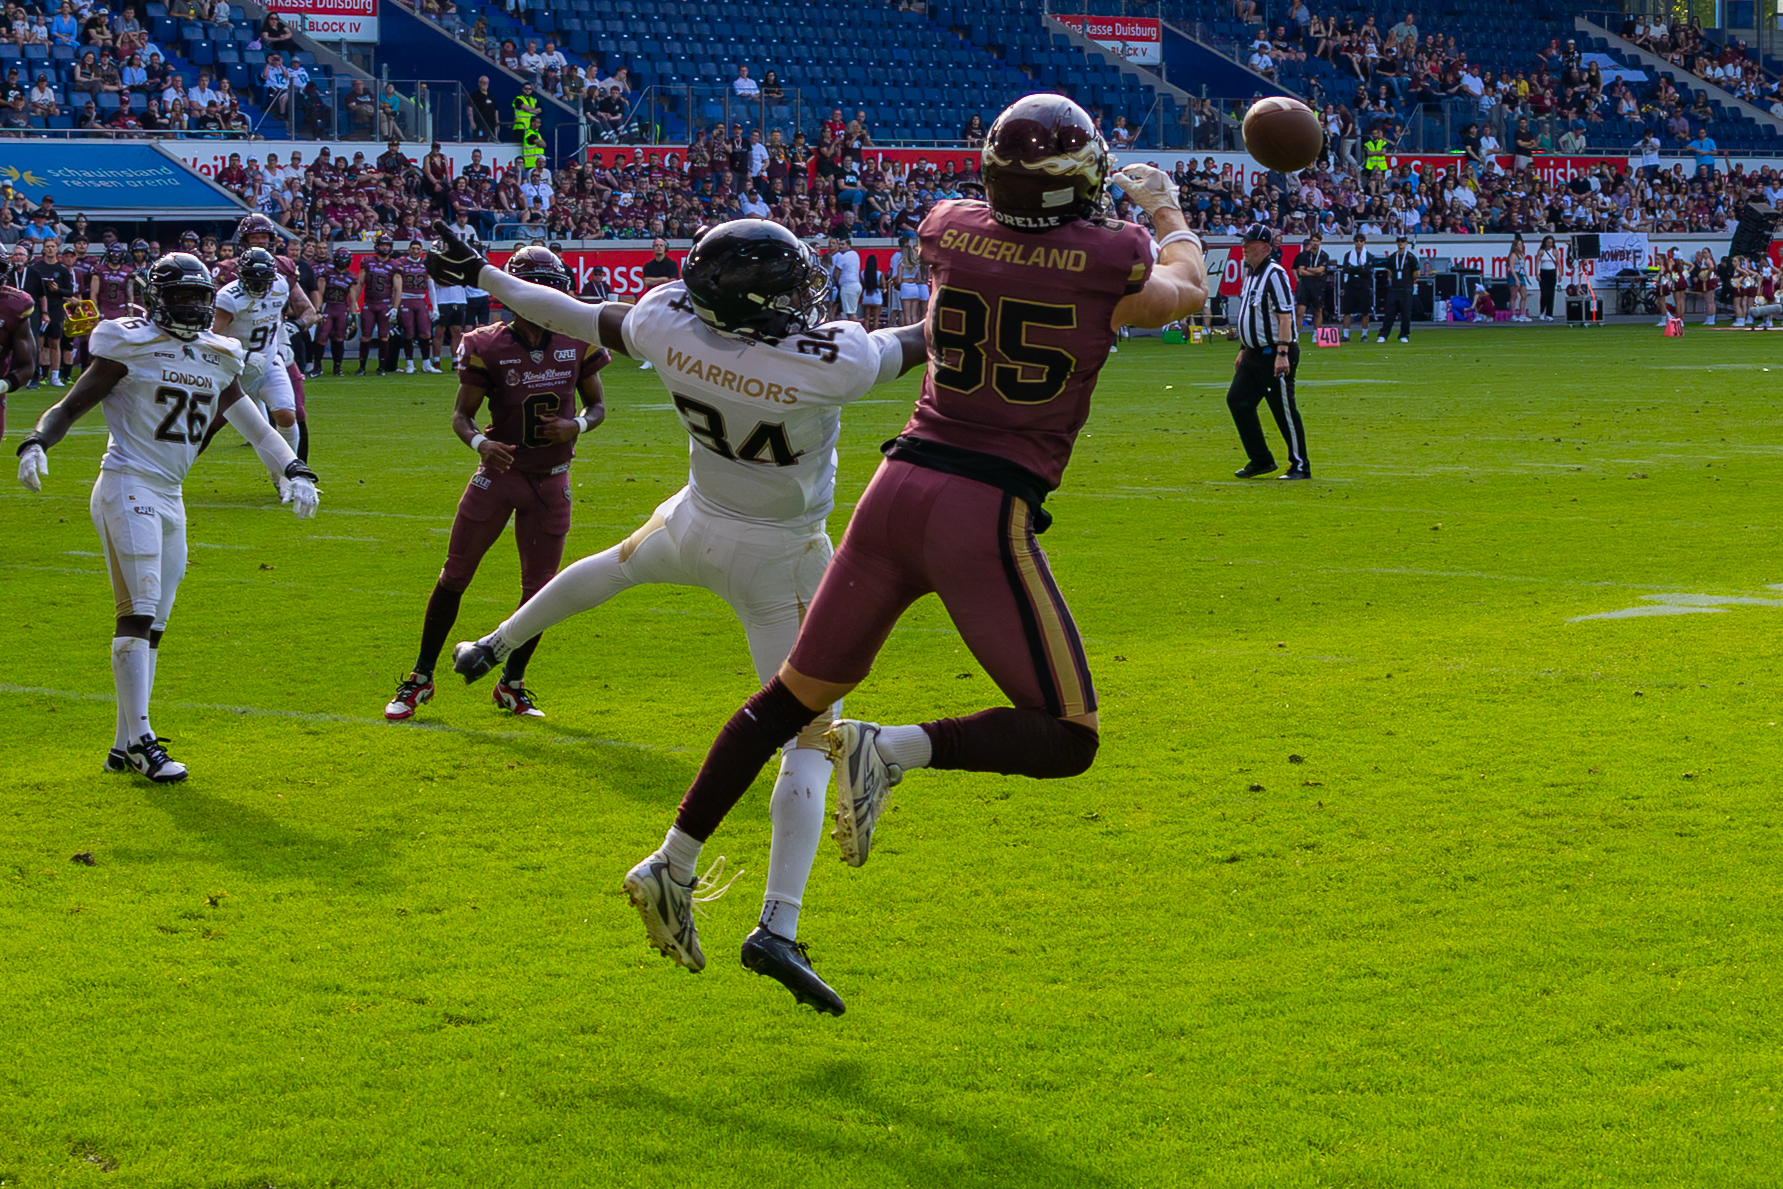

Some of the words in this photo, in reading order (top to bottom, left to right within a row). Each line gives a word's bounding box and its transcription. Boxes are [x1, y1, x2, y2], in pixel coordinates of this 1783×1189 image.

[308, 21, 346, 32] BLOCK
[349, 23, 361, 33] IV
[1064, 21, 1113, 36] Spakasse
[1115, 23, 1157, 40] Duisburg
[1111, 46, 1138, 57] BLCK
[1140, 47, 1148, 57] V
[47, 165, 174, 178] schauinsland
[61, 178, 125, 188] reisen
[127, 177, 181, 188] arena
[940, 228, 1087, 273] SAUERLAND
[107, 281, 119, 300] 3
[248, 321, 278, 352] 91
[1319, 328, 1338, 344] 40
[1672, 320, 1683, 337] 30
[933, 284, 1077, 405] 85
[162, 369, 213, 389] LONDON
[666, 347, 799, 405] WARRIORS
[154, 385, 215, 445] 26
[672, 391, 807, 467] 34
